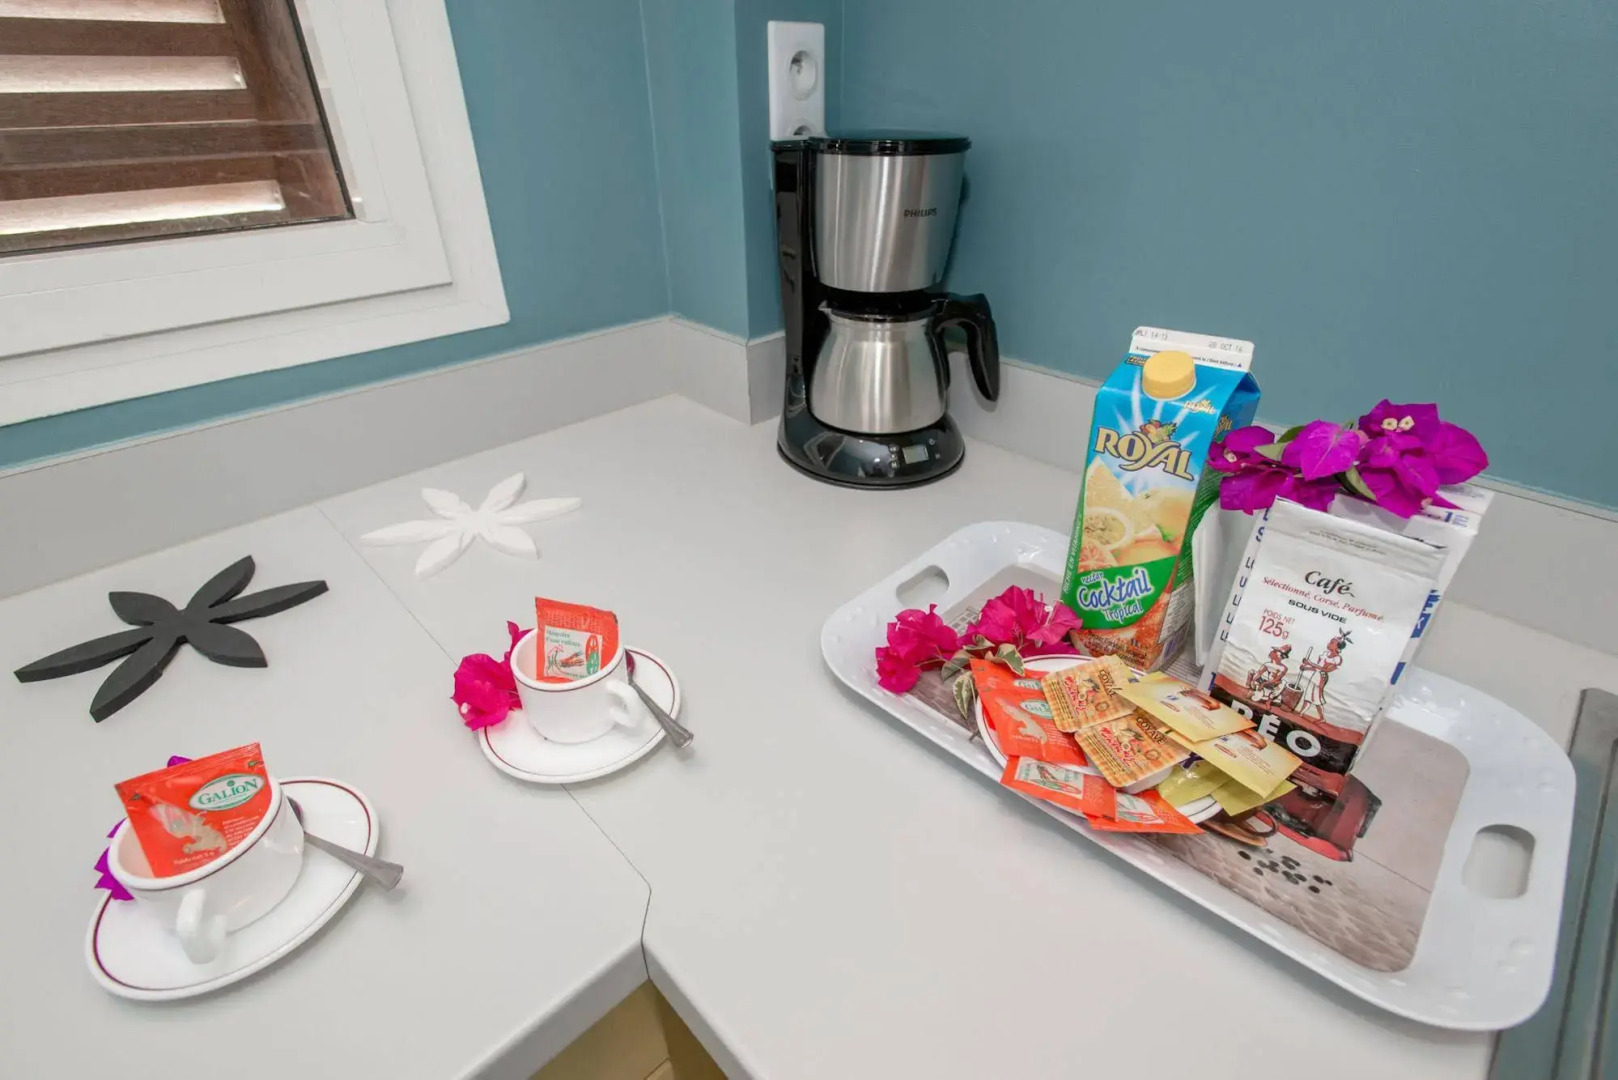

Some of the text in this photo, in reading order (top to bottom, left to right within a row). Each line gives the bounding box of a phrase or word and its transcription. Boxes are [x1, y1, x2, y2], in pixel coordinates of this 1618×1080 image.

[903, 207, 938, 218] PHILIPS
[1094, 426, 1195, 481] ROYAL
[1078, 568, 1153, 609] Cocktail
[1081, 572, 1104, 585] nectar
[1304, 570, 1356, 598] Café
[1102, 600, 1144, 624] Tropical
[1263, 608, 1297, 626] POIDS NET
[1288, 598, 1349, 625] SOUS VIDE
[1258, 615, 1291, 640] 125g
[1136, 716, 1165, 745] GOYAVE
[197, 778, 259, 806] GALION
